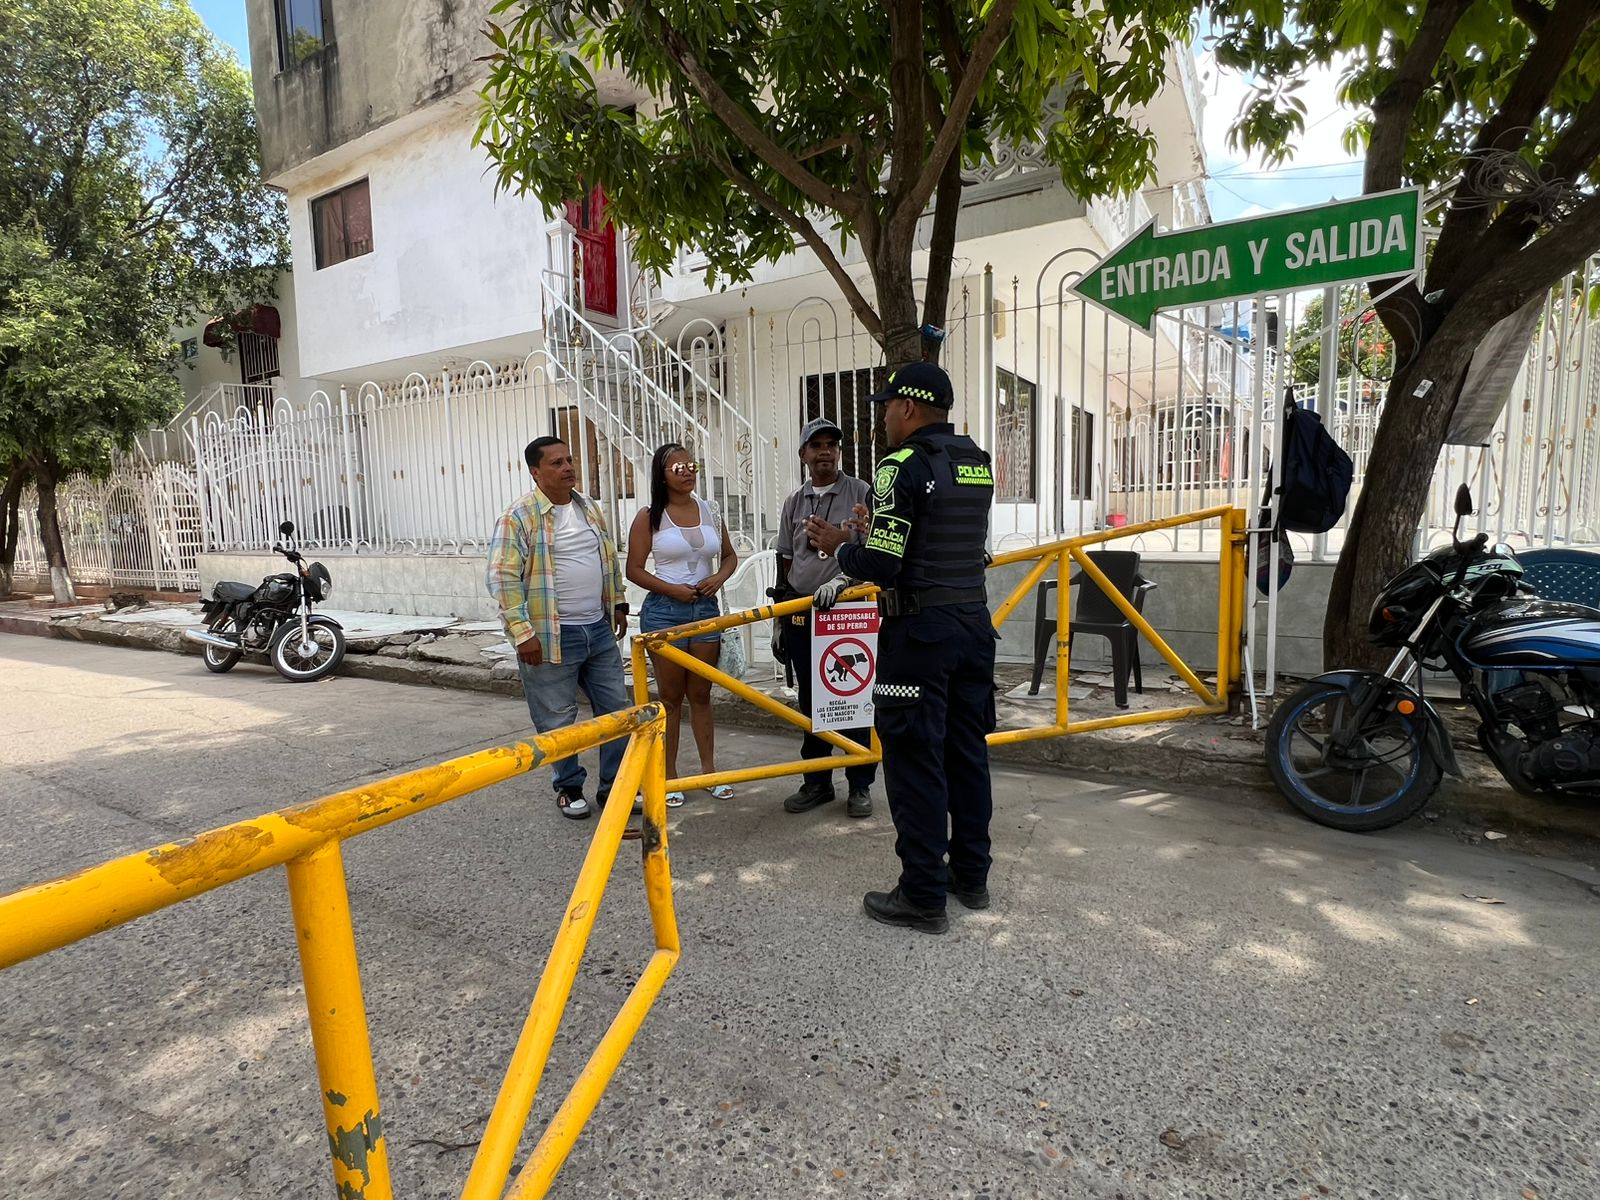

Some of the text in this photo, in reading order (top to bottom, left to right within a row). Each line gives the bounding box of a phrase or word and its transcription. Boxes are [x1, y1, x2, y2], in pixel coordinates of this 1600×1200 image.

[1101, 214, 1407, 301] ENTRADA Y SALIDA
[957, 464, 991, 478] POLICÍA
[818, 612, 876, 622] SEA RESPONSABLE
[827, 623, 835, 631] DE
[846, 622, 868, 630] PERRO
[826, 704, 859, 712] EXCREMENTOS
